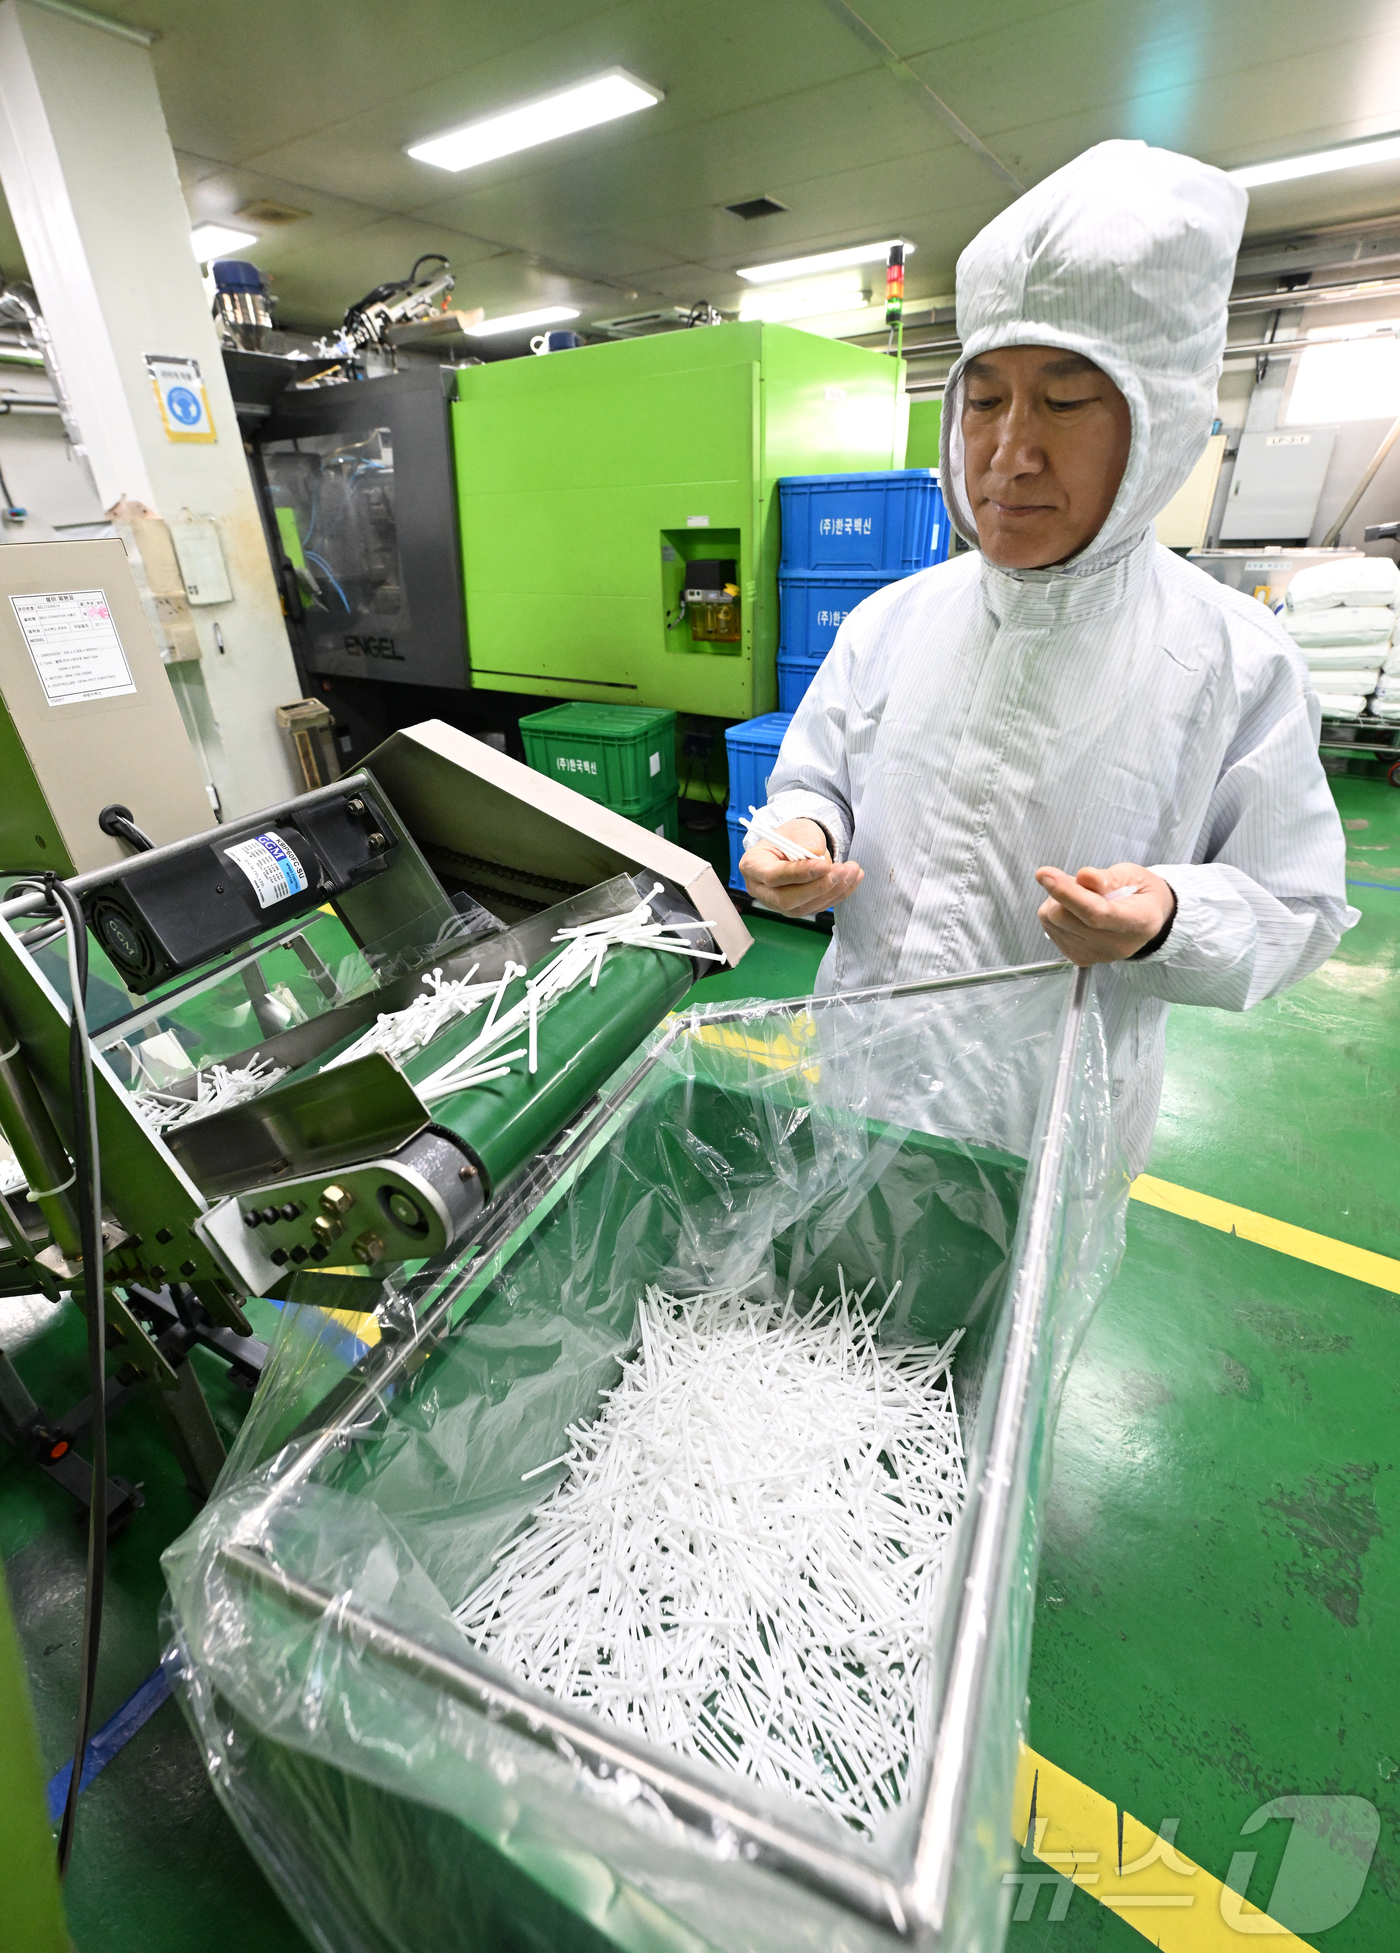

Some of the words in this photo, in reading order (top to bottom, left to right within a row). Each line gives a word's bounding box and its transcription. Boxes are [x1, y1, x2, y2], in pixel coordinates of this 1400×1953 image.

[1272, 436, 1305, 445] LP-3-1
[819, 517, 872, 535] (주)한국백신
[343, 635, 406, 661] ENGEL
[556, 757, 598, 775] (주)한국백신
[258, 836, 285, 861] GGM
[109, 920, 135, 956] GGM
